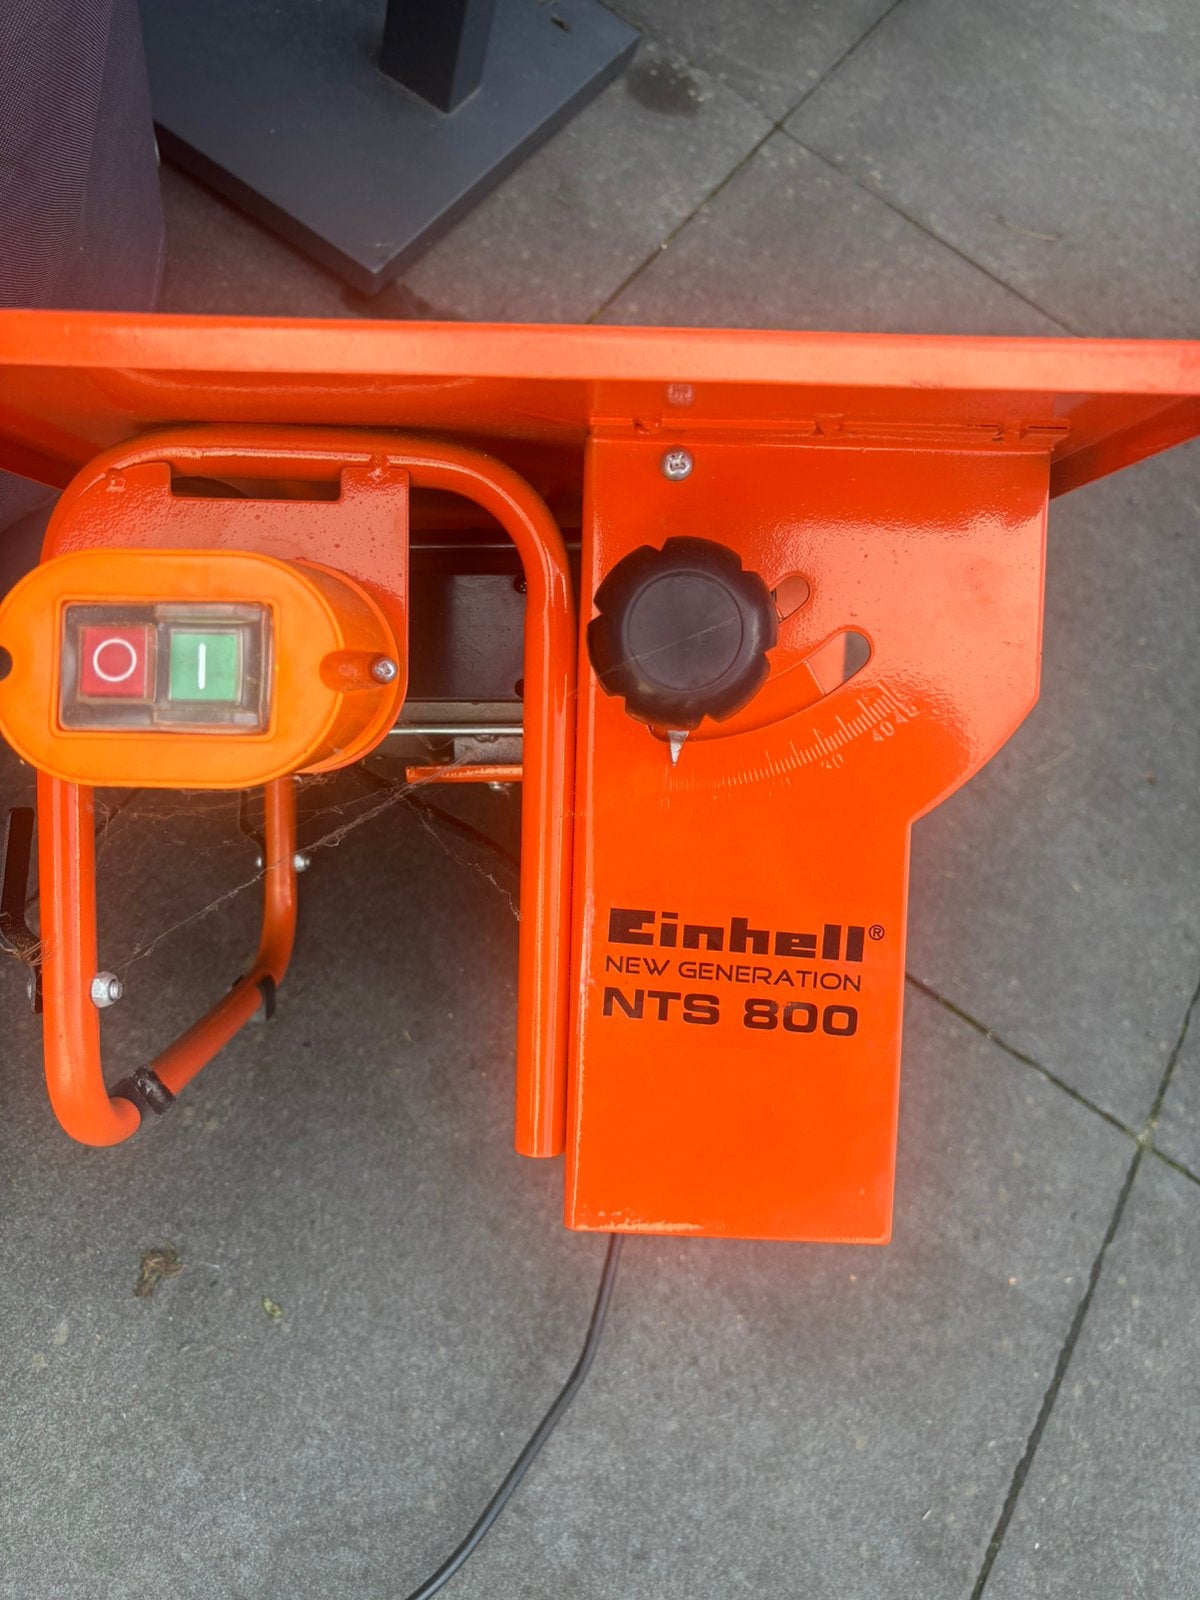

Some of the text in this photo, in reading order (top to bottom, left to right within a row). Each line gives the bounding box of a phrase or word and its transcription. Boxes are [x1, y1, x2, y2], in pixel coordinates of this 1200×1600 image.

[605, 955, 861, 992] NEW GENERATION
[603, 987, 858, 1036] NTS 800
